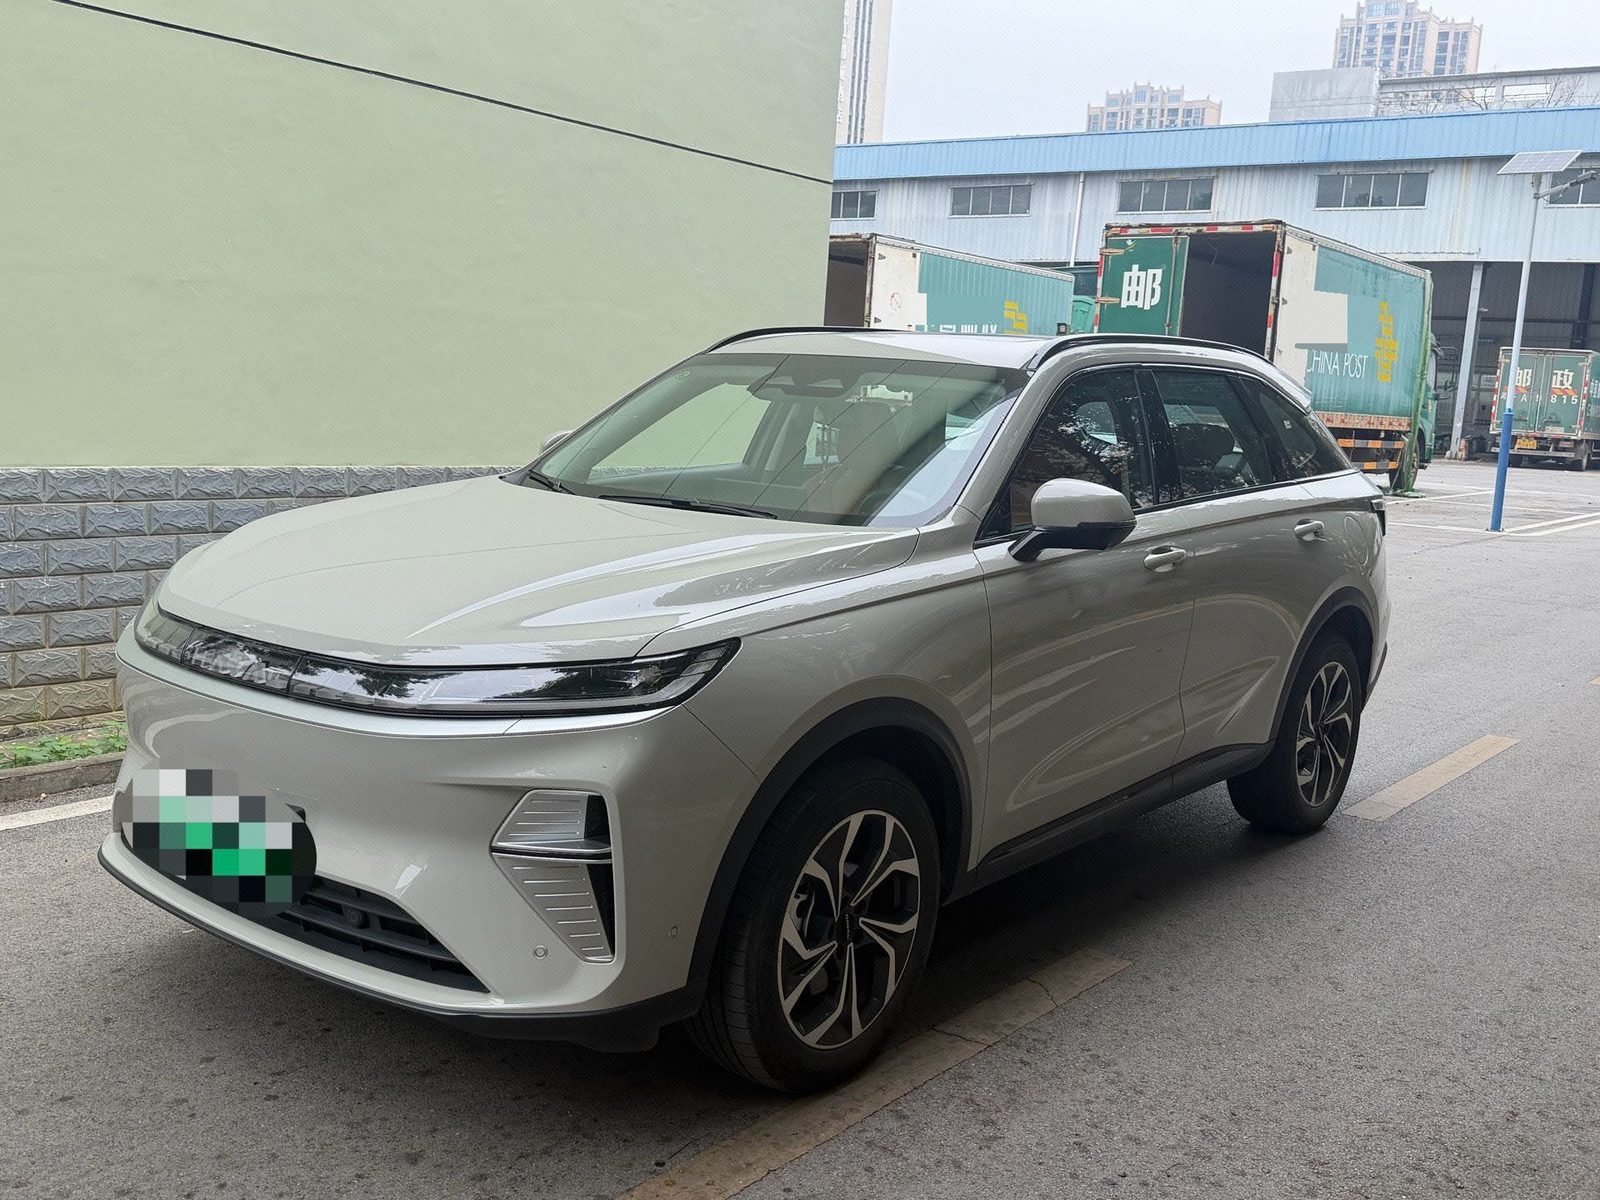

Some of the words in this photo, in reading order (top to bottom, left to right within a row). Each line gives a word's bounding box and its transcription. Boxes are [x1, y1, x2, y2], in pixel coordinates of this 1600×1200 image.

[1120, 263, 1163, 310] 邮
[1306, 349, 1340, 376] HINA
[1342, 352, 1369, 379] POST
